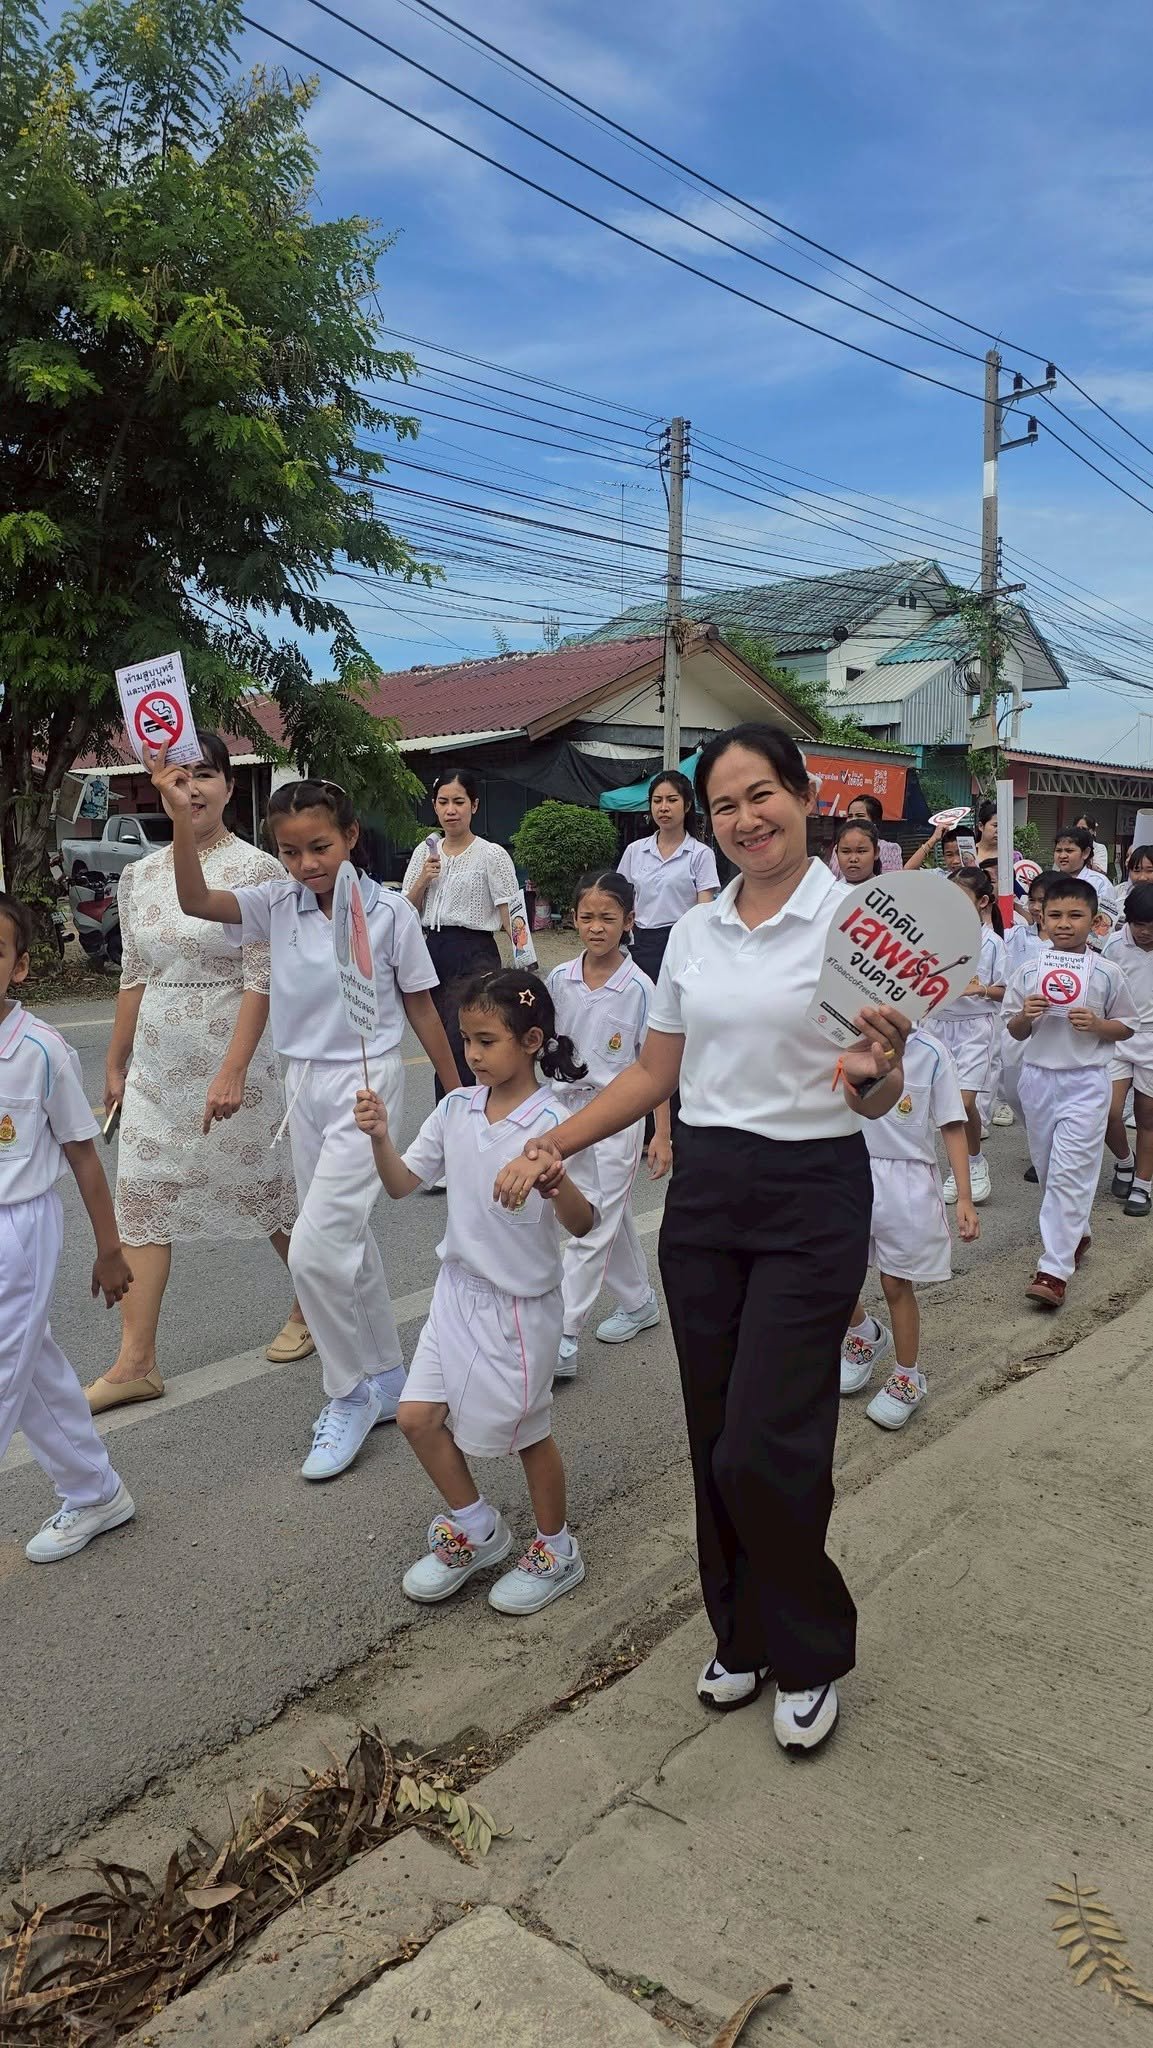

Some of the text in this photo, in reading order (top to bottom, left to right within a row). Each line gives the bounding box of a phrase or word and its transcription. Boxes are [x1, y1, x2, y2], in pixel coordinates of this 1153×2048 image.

[124, 658, 174, 684] ห้ามสูบบุหรี่
[865, 887, 924, 945] นิโคติน
[838, 907, 950, 1019] เสพติด
[850, 951, 907, 1002] จนตาย
